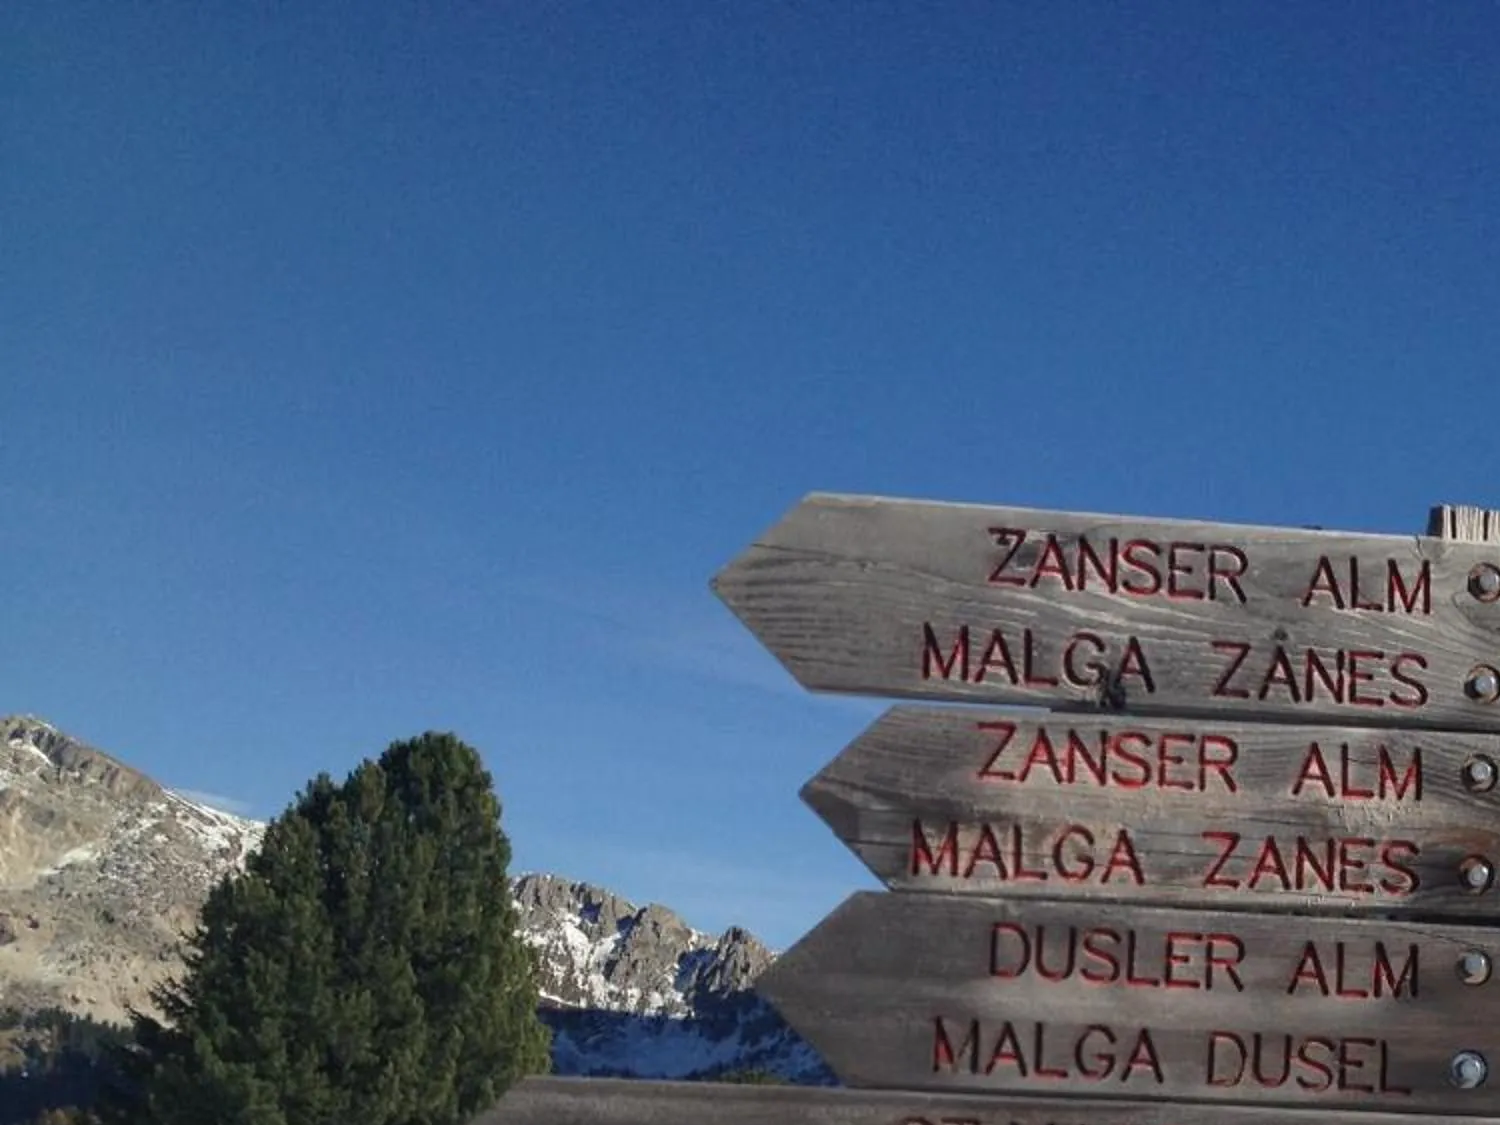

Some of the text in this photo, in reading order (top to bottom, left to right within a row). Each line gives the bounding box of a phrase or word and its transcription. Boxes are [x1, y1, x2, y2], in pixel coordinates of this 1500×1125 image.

[987, 527, 1432, 614] ZANSER ALM
[921, 621, 1429, 708] MALGA ZANES
[975, 722, 1423, 801] ZANSER ALM
[910, 818, 1420, 896] MALGA ZANES
[988, 921, 1419, 1001] DUSLER ALM
[931, 1016, 1413, 1096] MALGA DUSEL
